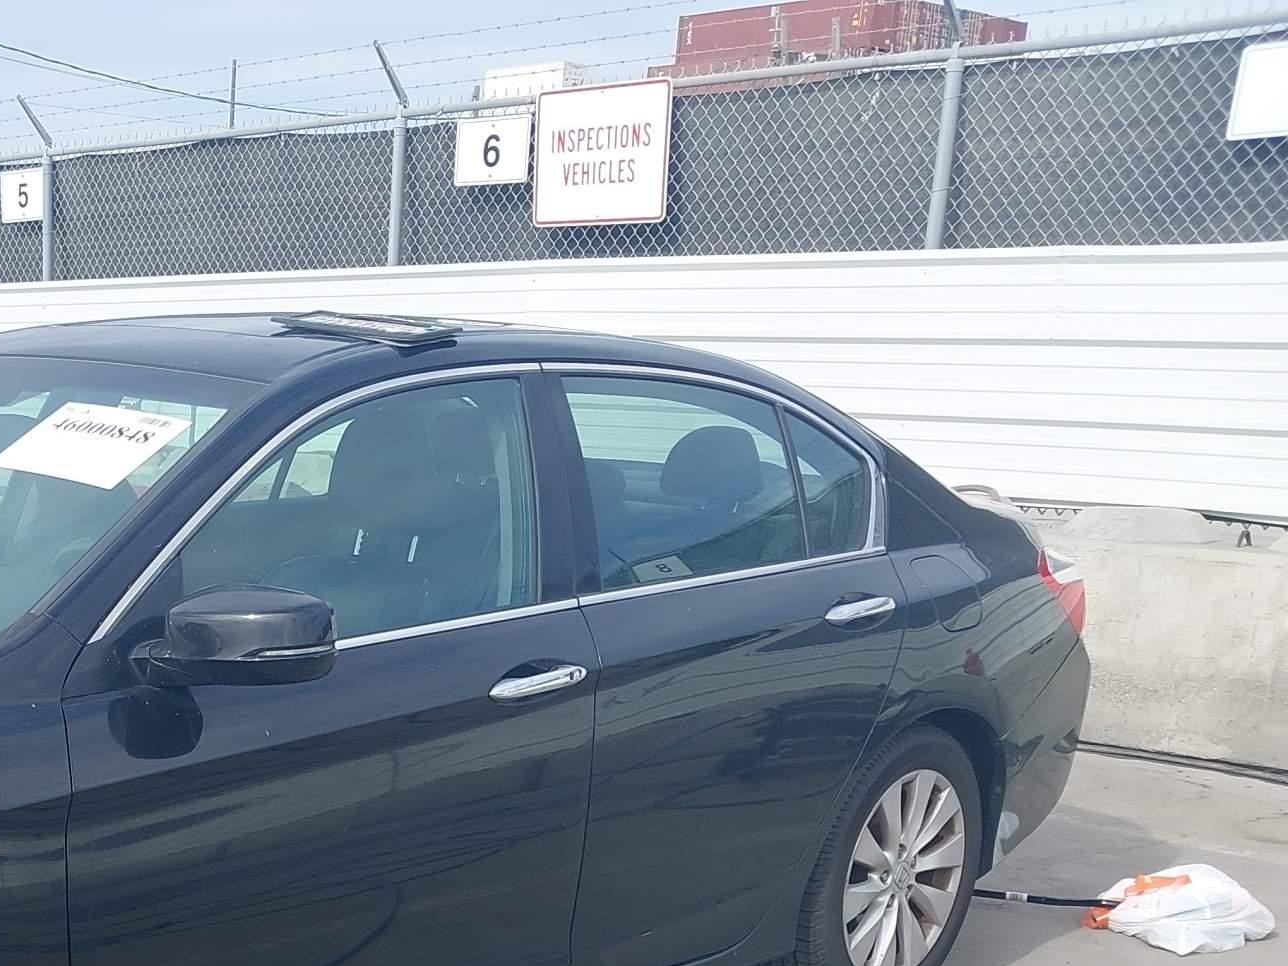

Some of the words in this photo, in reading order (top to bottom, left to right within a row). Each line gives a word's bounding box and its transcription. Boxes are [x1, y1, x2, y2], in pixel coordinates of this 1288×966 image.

[483, 134, 501, 168] 6
[551, 122, 652, 154] INSPECTIONS
[562, 158, 636, 186] VEHICLES
[18, 183, 29, 208] 5
[52, 416, 156, 444] 46000848
